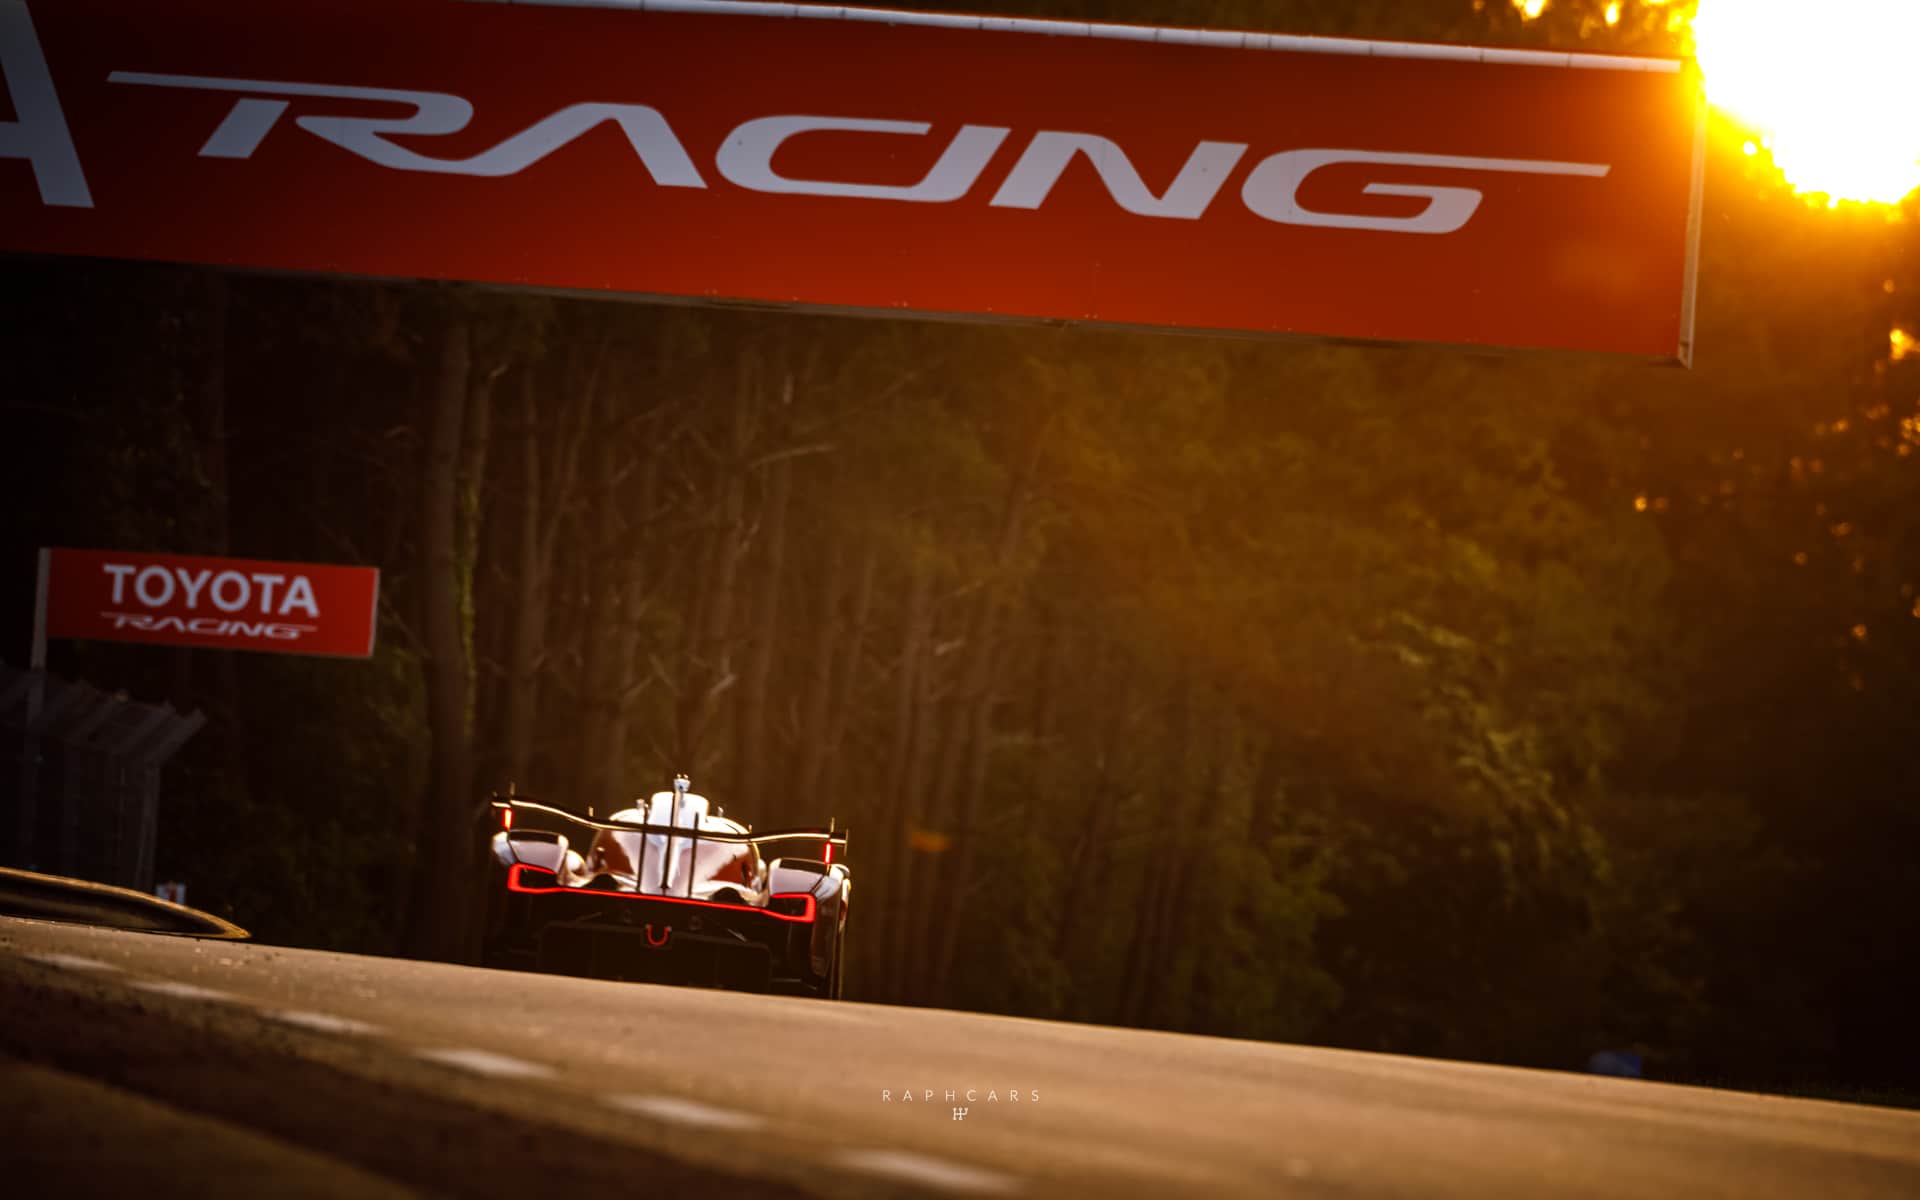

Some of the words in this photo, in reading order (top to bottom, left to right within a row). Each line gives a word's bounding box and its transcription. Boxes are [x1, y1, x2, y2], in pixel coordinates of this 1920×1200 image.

[107, 71, 1610, 234] RACING
[103, 564, 319, 617] TOYOTA
[101, 612, 318, 639] RACING
